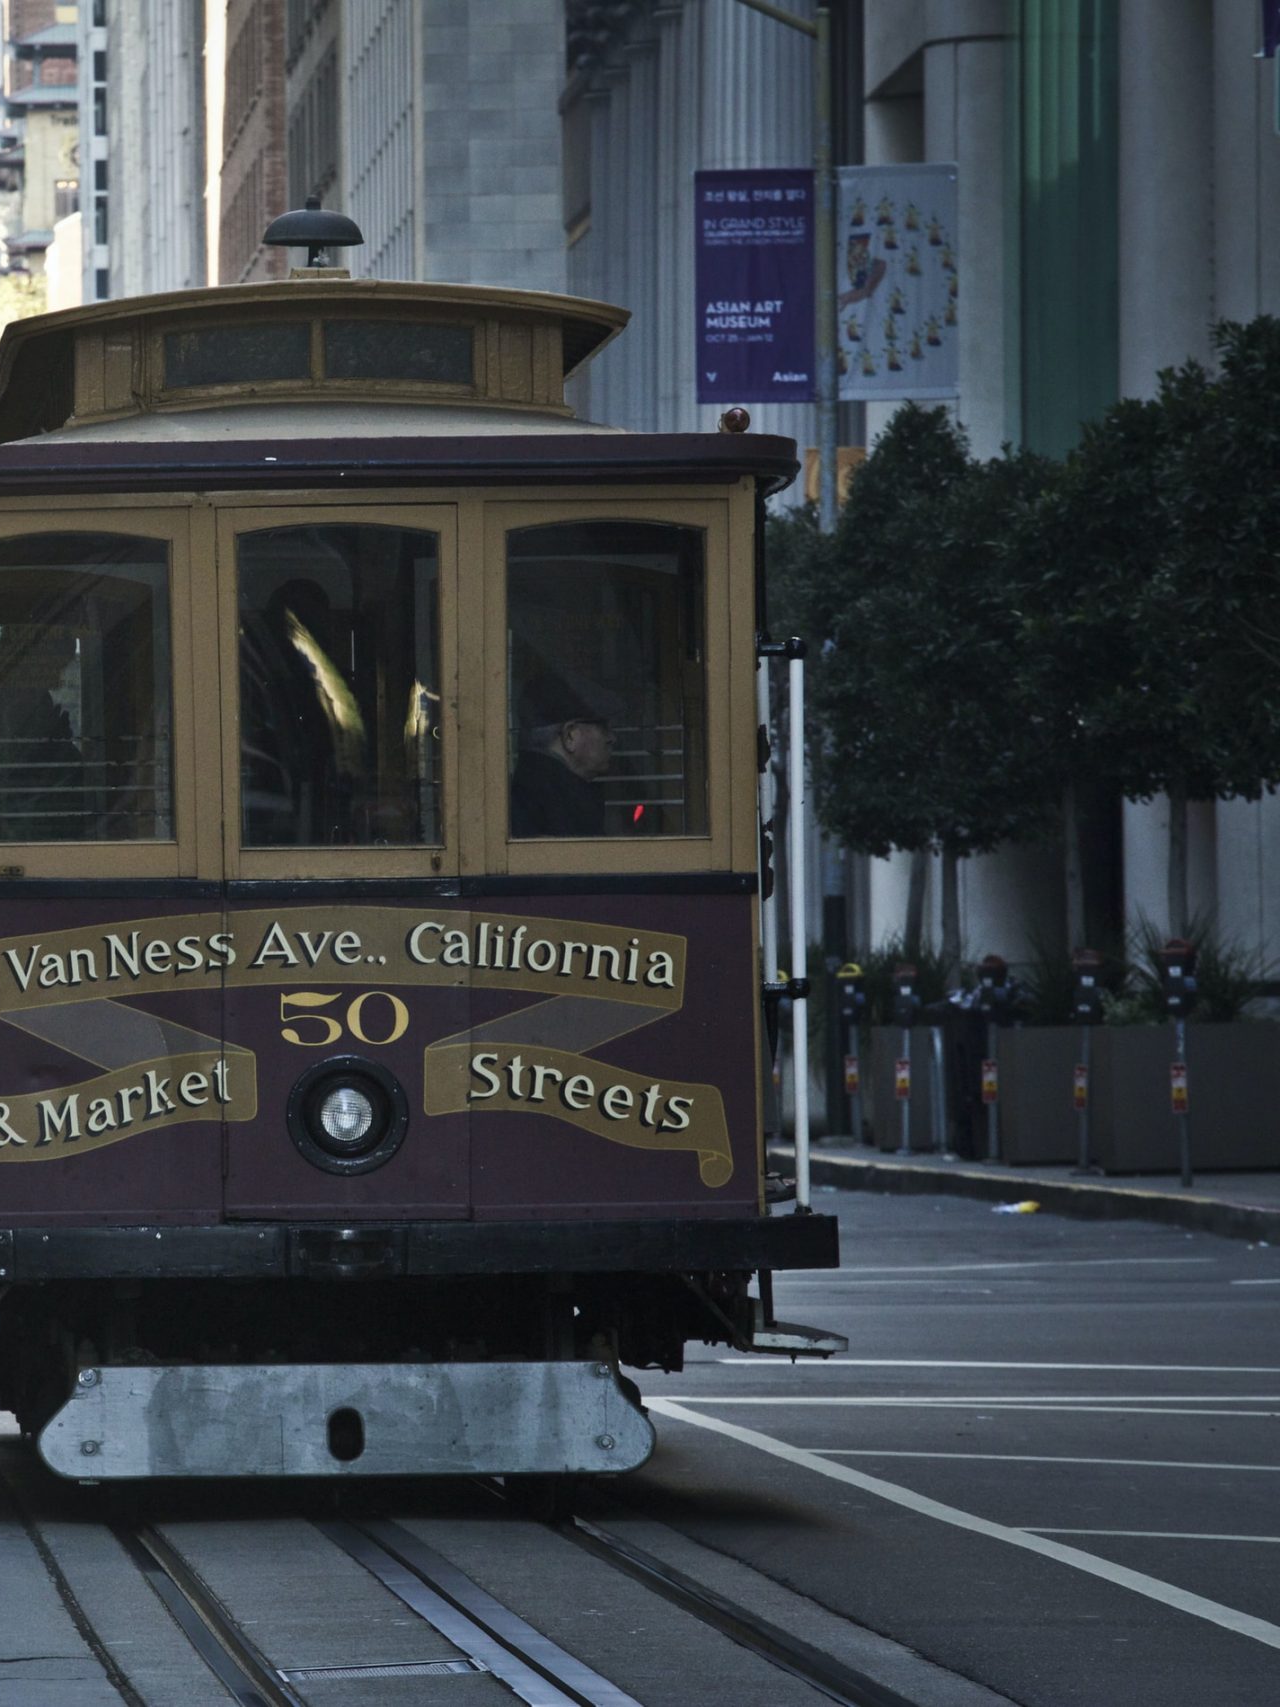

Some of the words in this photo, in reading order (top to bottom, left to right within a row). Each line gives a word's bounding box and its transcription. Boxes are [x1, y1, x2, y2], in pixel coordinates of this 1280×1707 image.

[703, 218, 717, 230] IN
[719, 216, 766, 230] GRAND
[768, 215, 806, 230] STYLE
[705, 300, 751, 314] ASIAN
[754, 299, 784, 313] ART
[705, 315, 772, 329] MUSEUM
[705, 333, 725, 343] OCT
[772, 371, 809, 382] Asian
[5, 944, 99, 991] Van
[104, 930, 237, 980] Ness
[408, 921, 676, 987] California
[280, 990, 410, 1047] 50
[39, 1058, 233, 1144] Market
[469, 1051, 695, 1130] Streets
